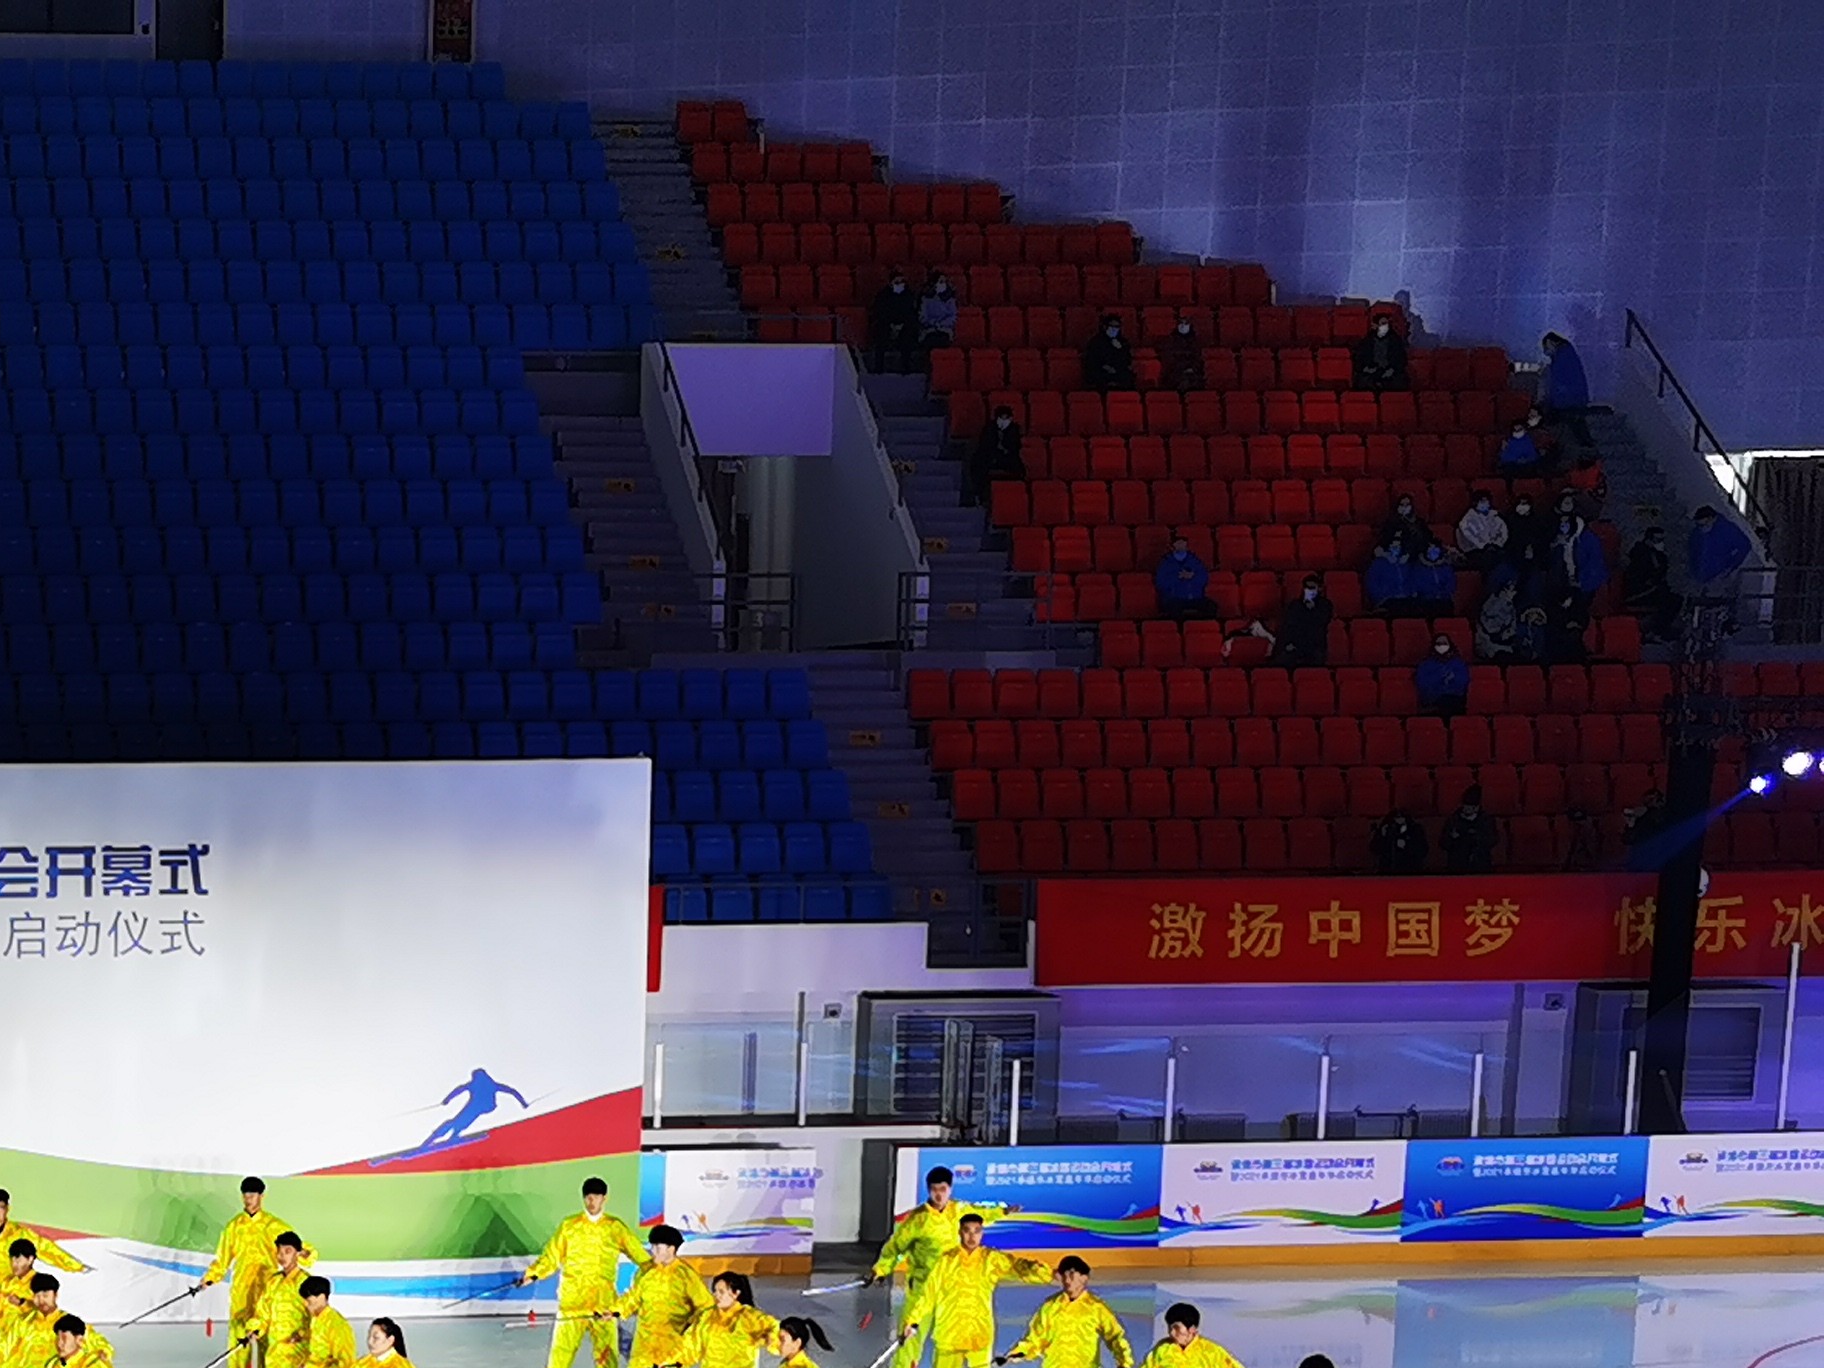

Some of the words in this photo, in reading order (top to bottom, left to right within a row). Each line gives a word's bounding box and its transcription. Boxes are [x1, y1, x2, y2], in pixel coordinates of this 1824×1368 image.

[1147, 897, 1522, 959] 激扬中国梦
